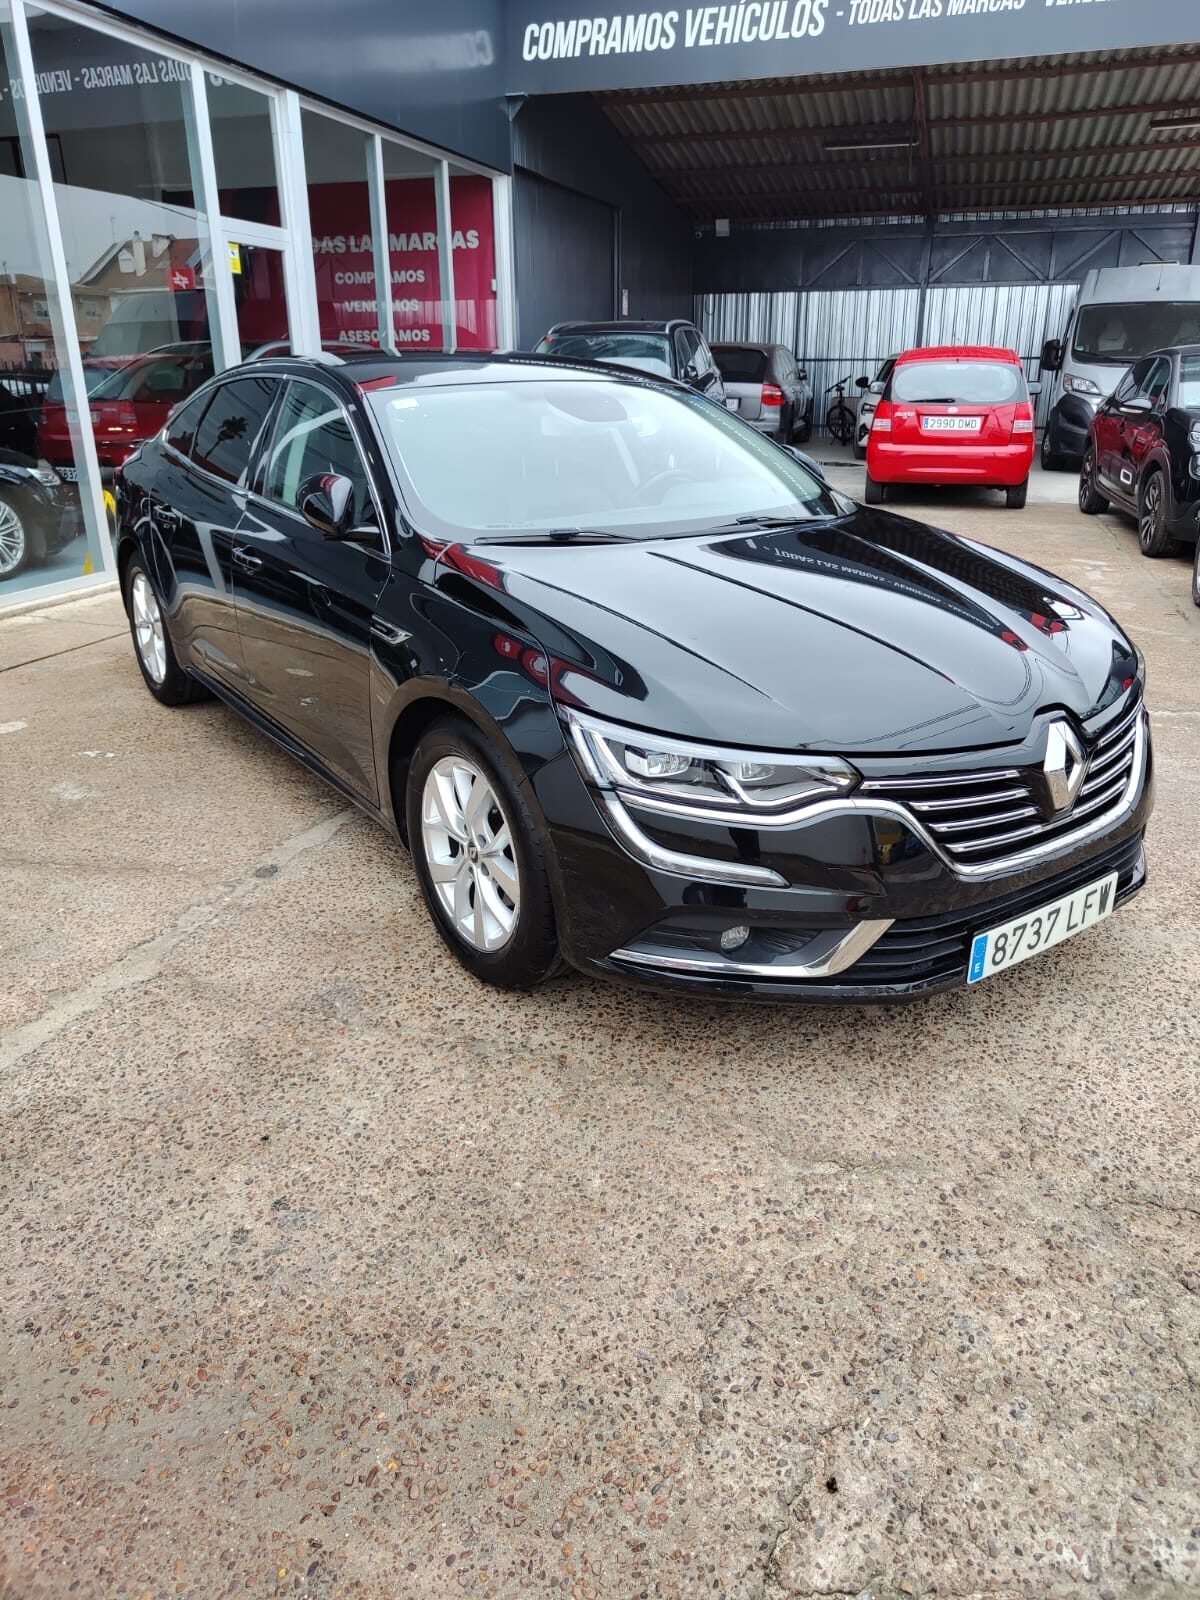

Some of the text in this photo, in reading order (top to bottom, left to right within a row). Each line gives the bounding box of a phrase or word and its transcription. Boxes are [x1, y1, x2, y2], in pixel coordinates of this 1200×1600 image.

[523, 11, 679, 61] COMPRAMOS
[685, 0, 829, 47] VEHÍCULOS
[848, 0, 904, 25] TODAS
[908, 0, 943, 20] LAS
[350, 235, 374, 253] LA
[335, 270, 425, 285] COMPAMOS
[344, 299, 420, 313] VENDMOS
[339, 329, 430, 343] ASESOAMOS
[929, 418, 977, 429] 2990 DMD
[974, 880, 1113, 973] E 8737 LFW
